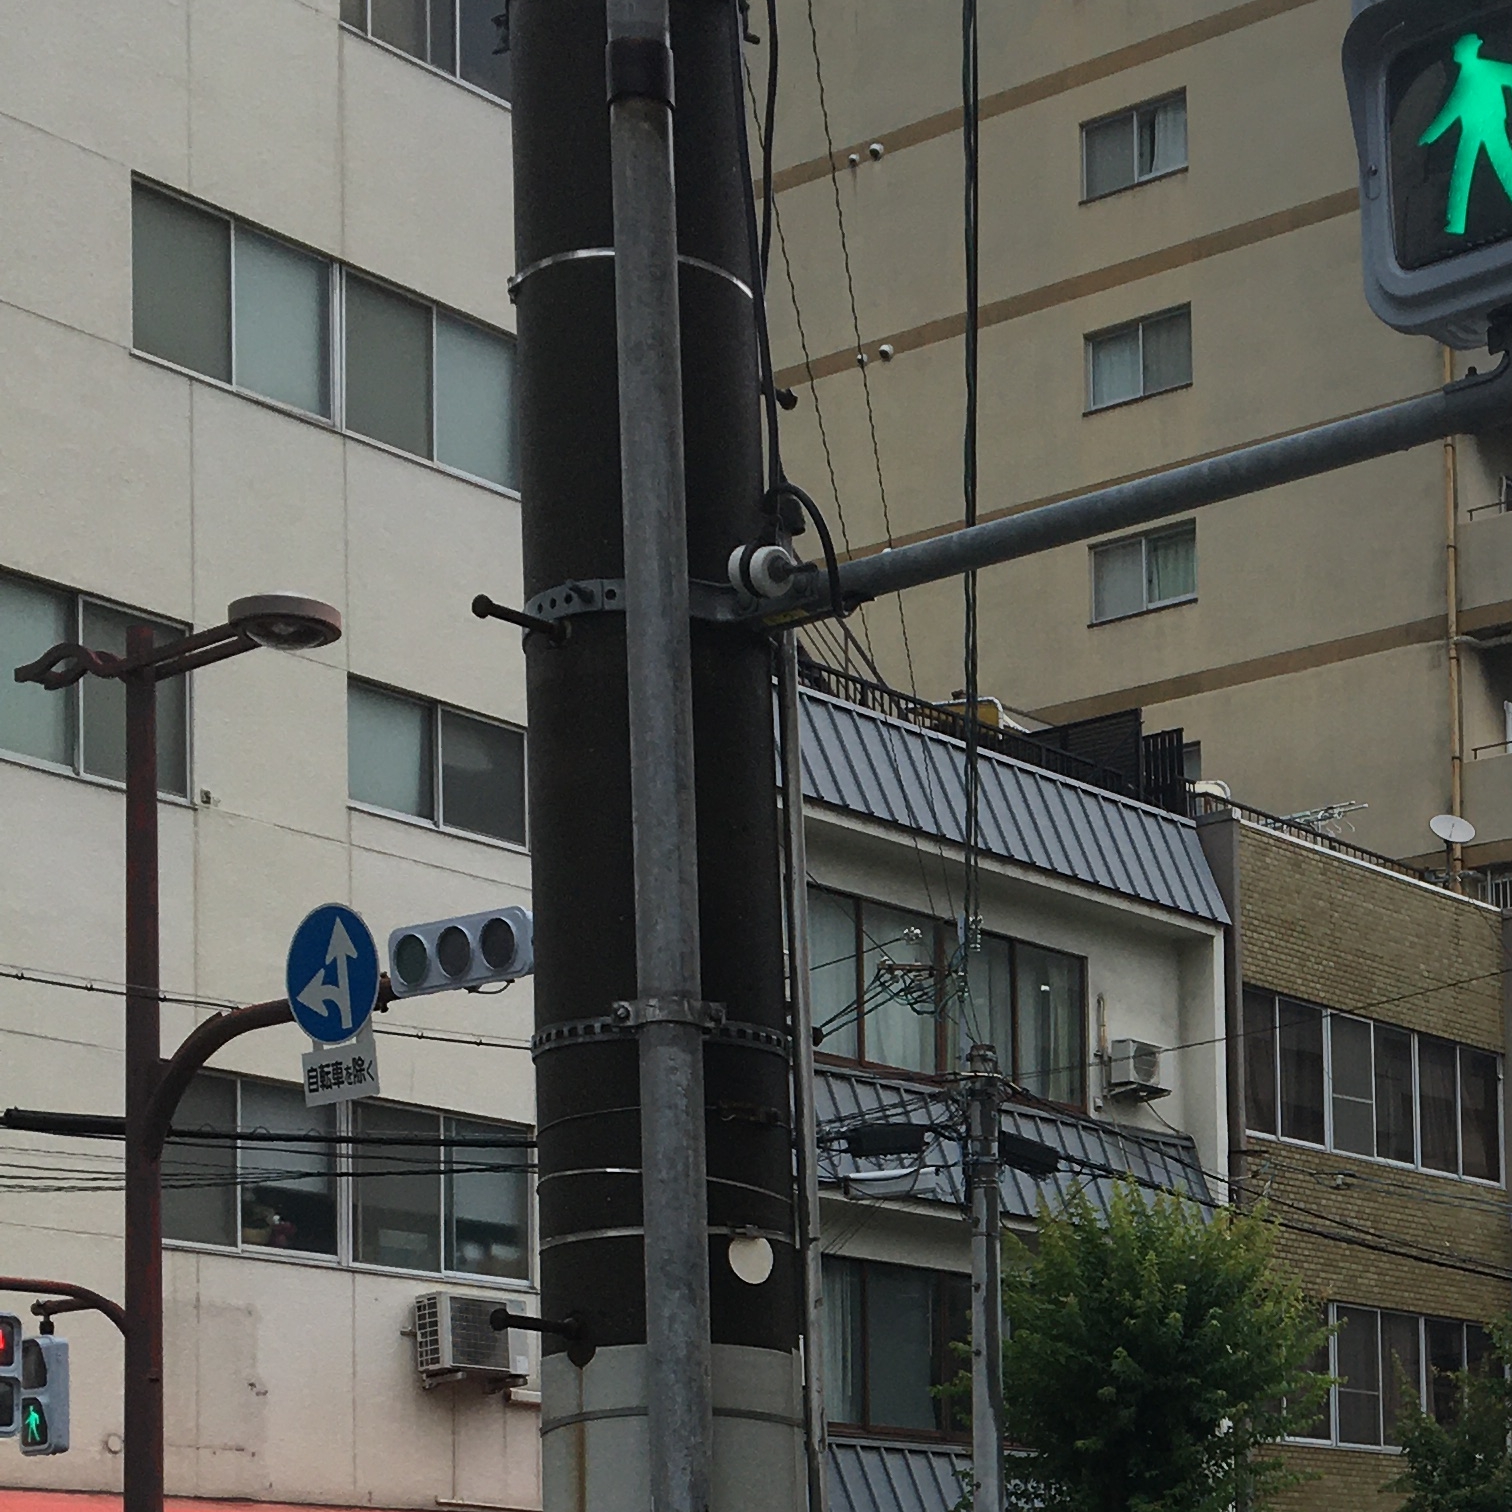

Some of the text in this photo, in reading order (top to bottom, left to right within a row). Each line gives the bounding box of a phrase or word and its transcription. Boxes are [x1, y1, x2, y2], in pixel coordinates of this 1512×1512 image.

[306, 1056, 375, 1093] 自転車を除く
